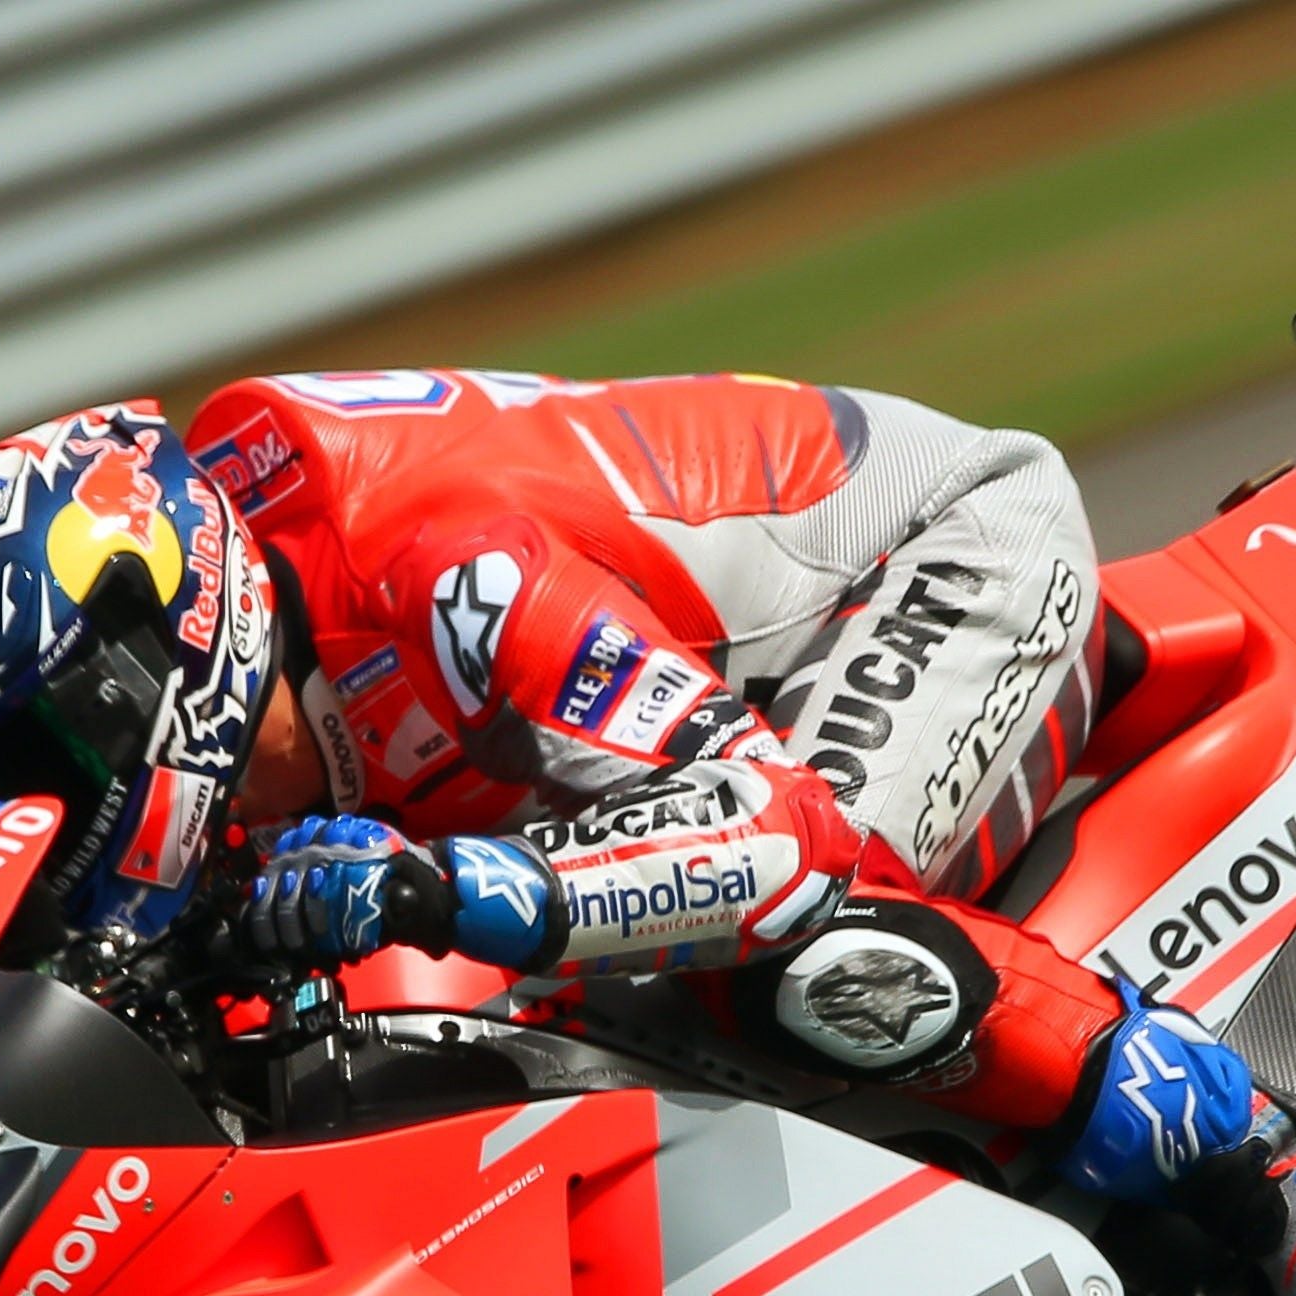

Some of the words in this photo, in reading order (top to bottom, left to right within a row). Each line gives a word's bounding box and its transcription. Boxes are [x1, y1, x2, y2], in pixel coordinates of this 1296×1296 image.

[636, 660, 691, 725] riell
[805, 561, 988, 807] DUCATI
[321, 712, 358, 803] Lenovo
[181, 783, 210, 849] DUCATI
[530, 779, 739, 854] DUCATI
